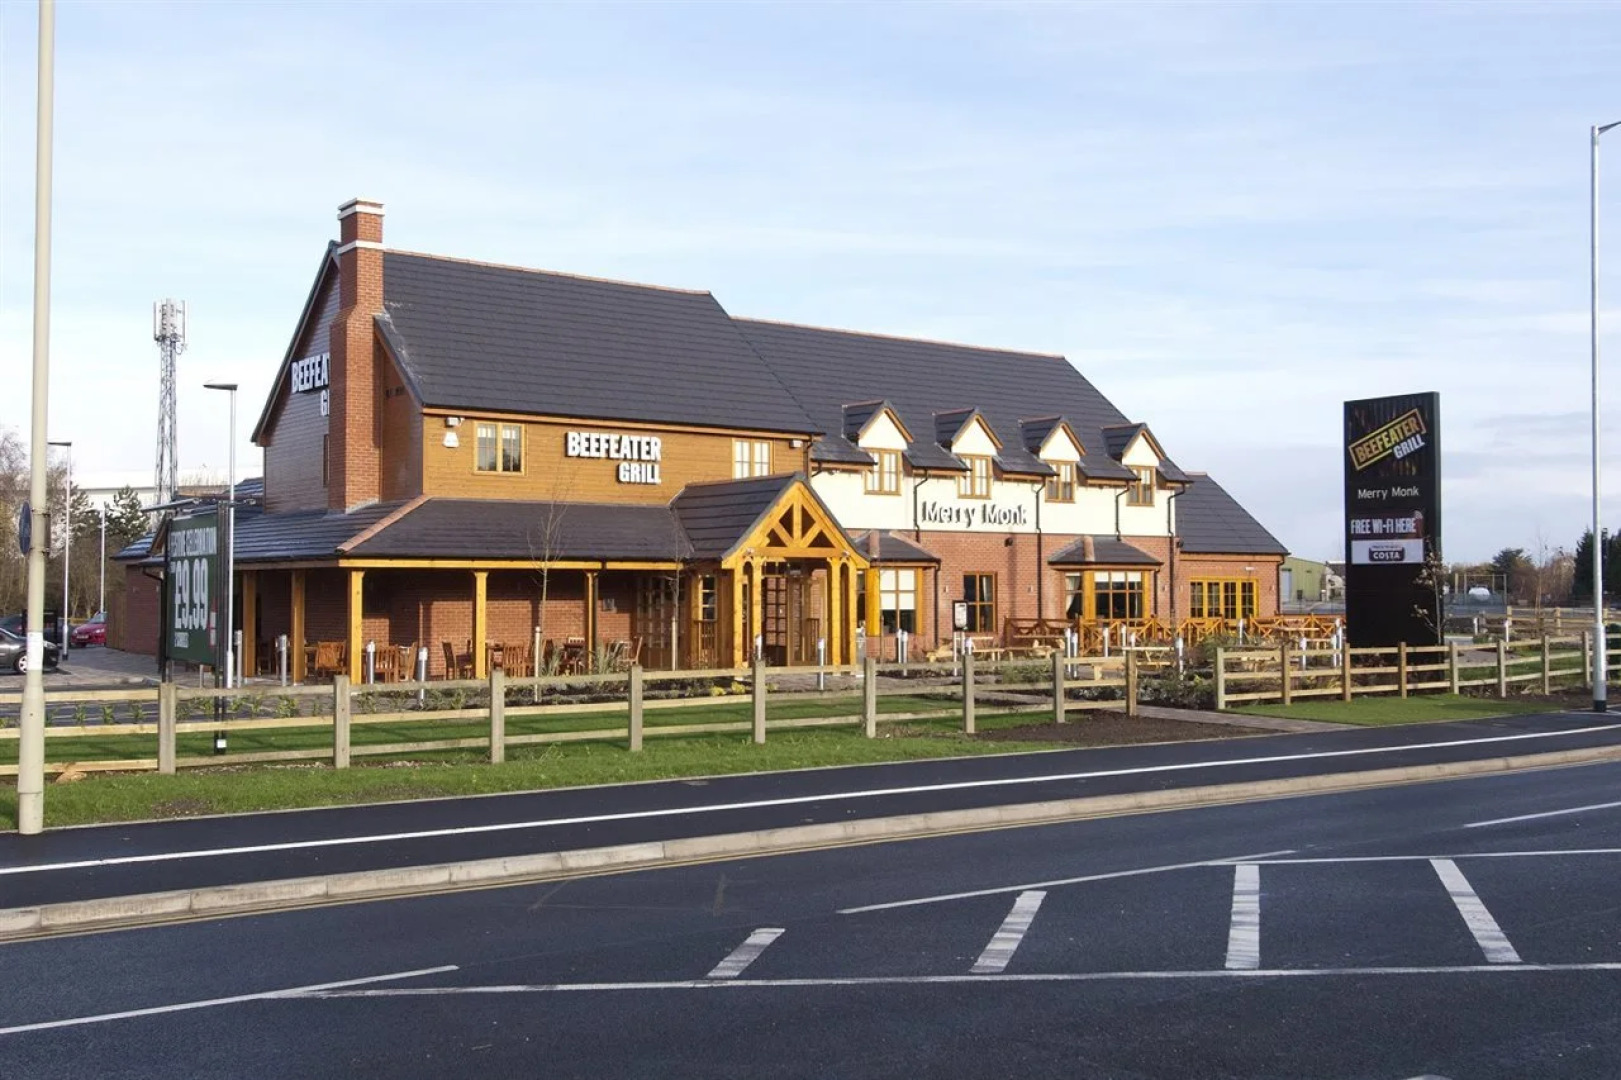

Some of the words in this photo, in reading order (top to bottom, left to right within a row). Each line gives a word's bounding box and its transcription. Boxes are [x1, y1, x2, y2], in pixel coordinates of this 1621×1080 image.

[566, 431, 661, 461] BEEFEATER
[1355, 417, 1420, 463] BEEFEATER
[1393, 434, 1425, 460] GRILL
[618, 461, 661, 484] GRILL
[1358, 488, 1388, 500] Merry
[1391, 486, 1419, 498] Monk
[922, 501, 976, 528] Merry
[982, 503, 1027, 525] Monk
[1350, 519, 1371, 534] FREE
[1372, 518, 1394, 533] WI-FI
[1395, 517, 1417, 533] HERE
[1373, 551, 1401, 560] COSTA
[174, 558, 208, 630] £9.99
